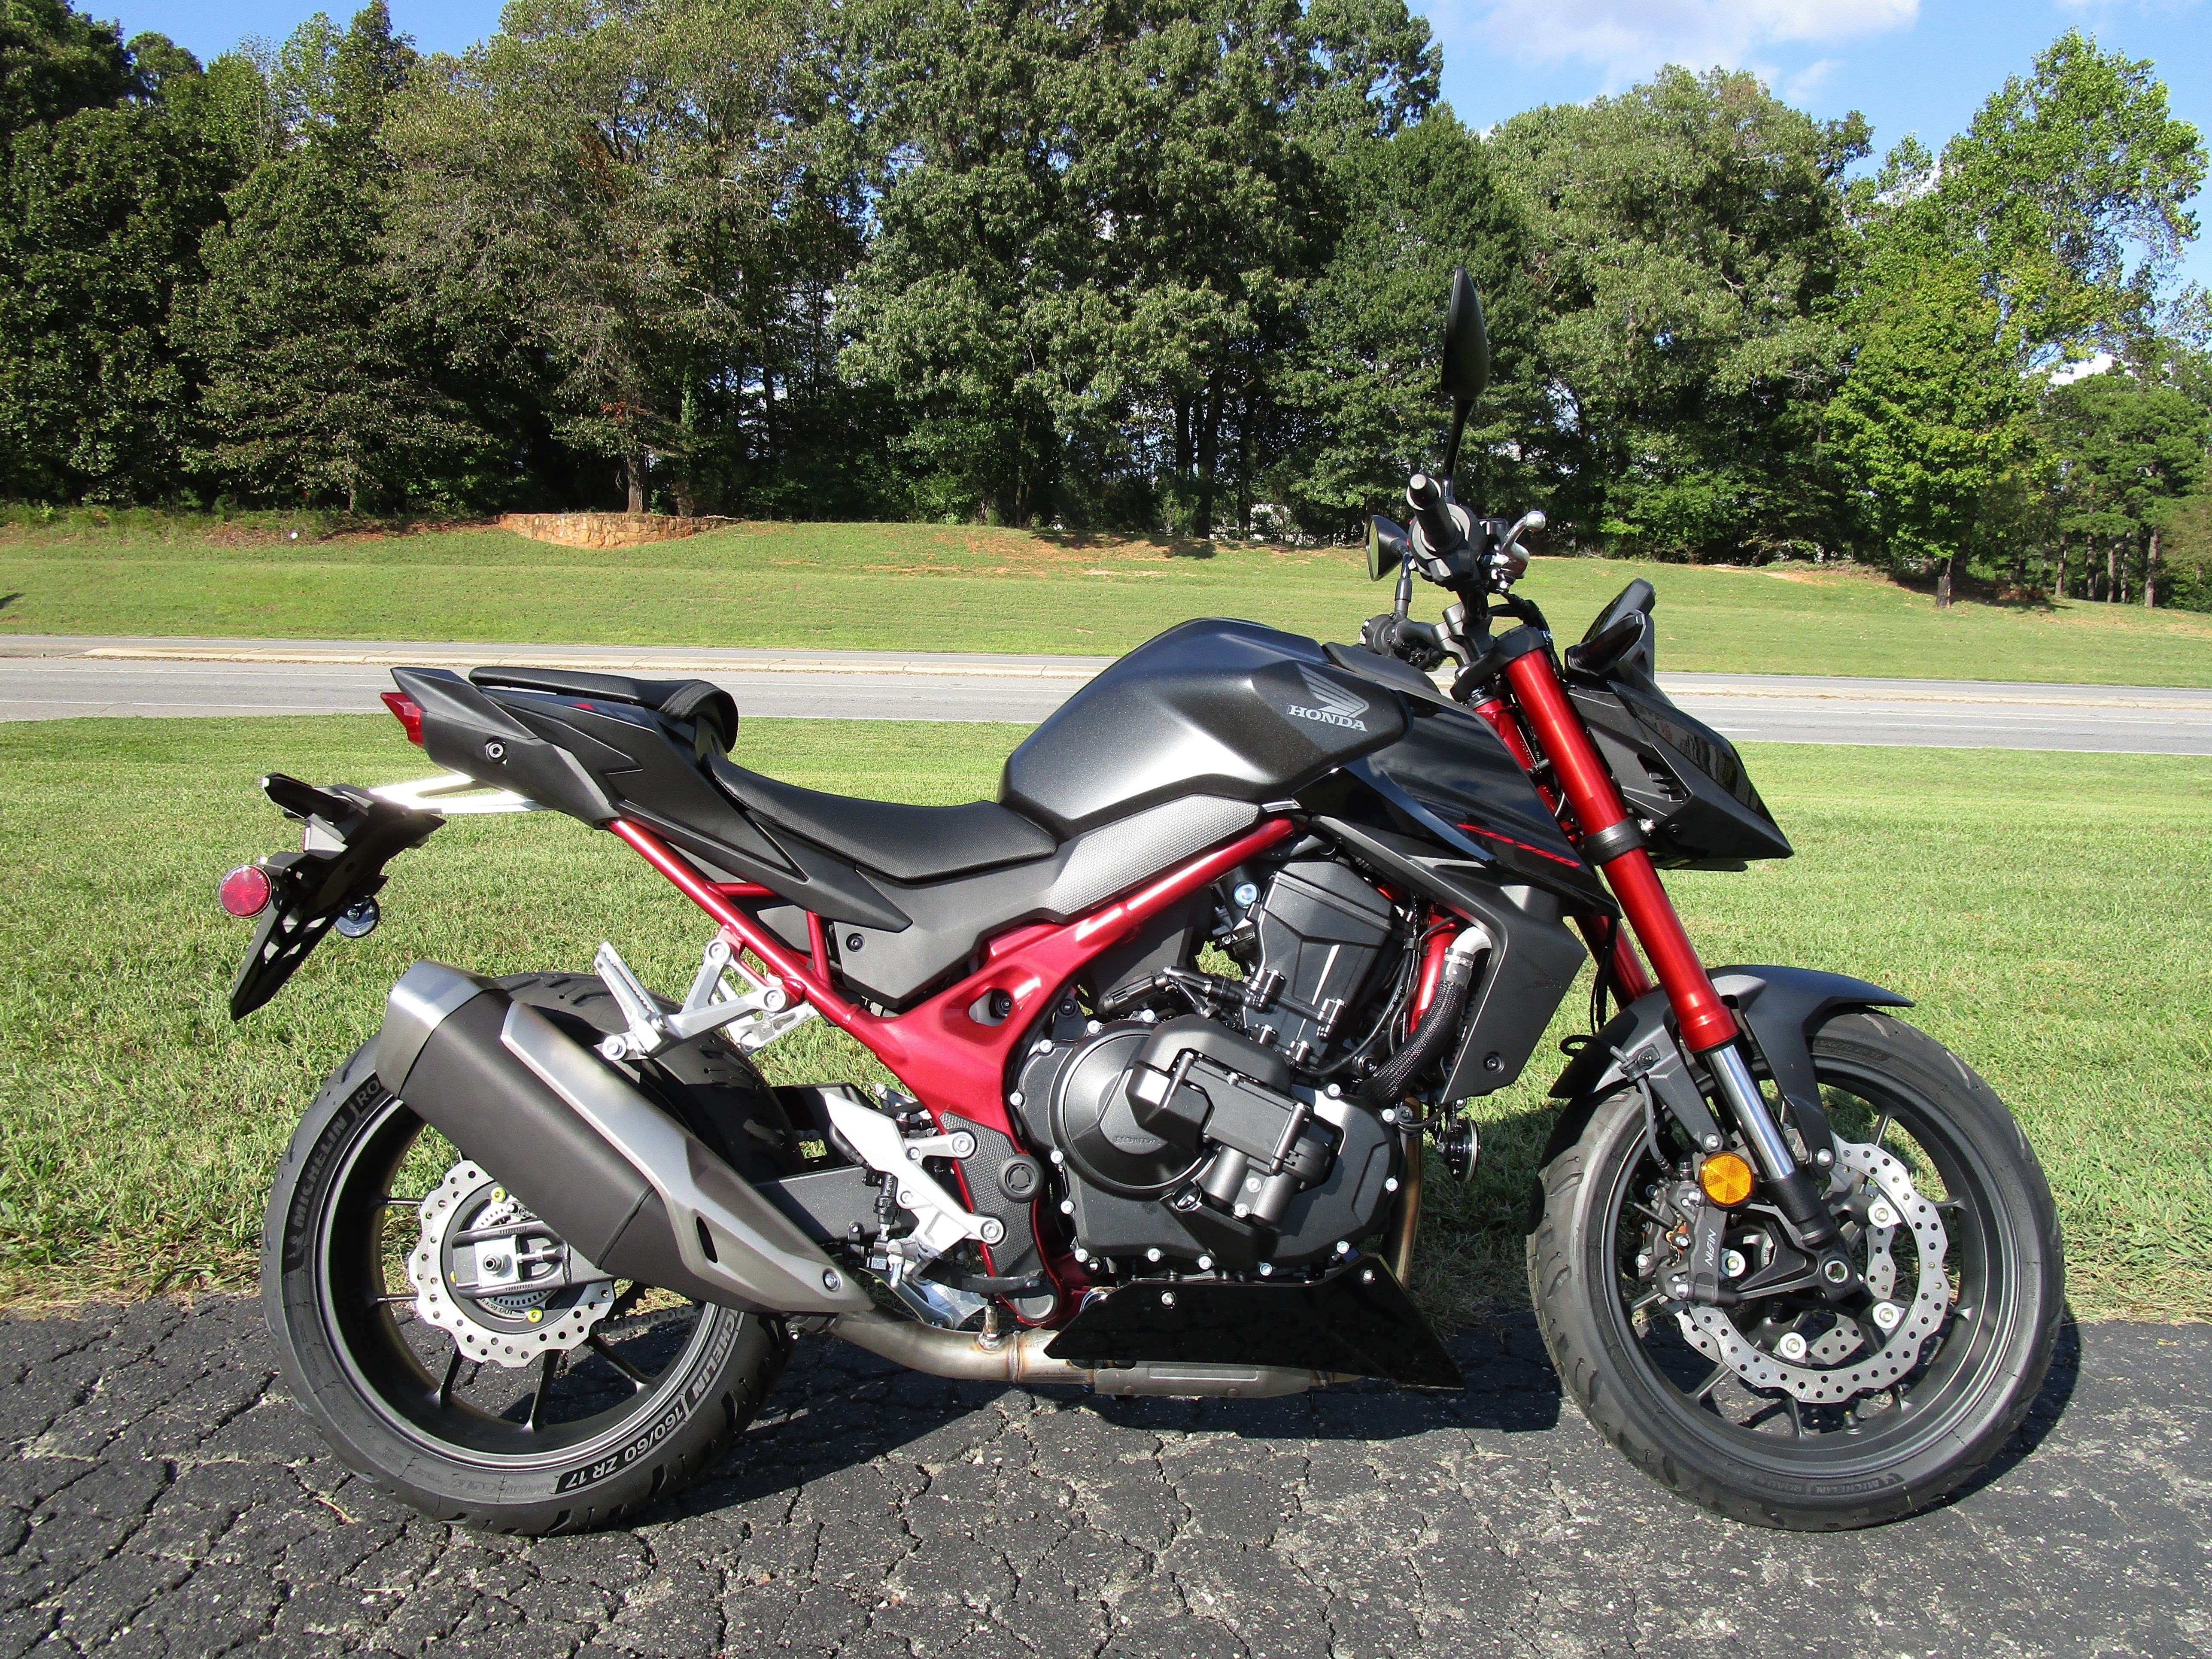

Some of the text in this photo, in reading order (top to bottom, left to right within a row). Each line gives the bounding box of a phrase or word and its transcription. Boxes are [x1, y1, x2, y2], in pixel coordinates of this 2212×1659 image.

[1288, 704, 1367, 732] HONDA
[292, 1115, 347, 1228] MICHELIN
[625, 1407, 684, 1462] 160/60
[565, 1470, 587, 1489] 17
[592, 1455, 618, 1479] ZR
[1816, 1479, 1880, 1494] MICHELIN
